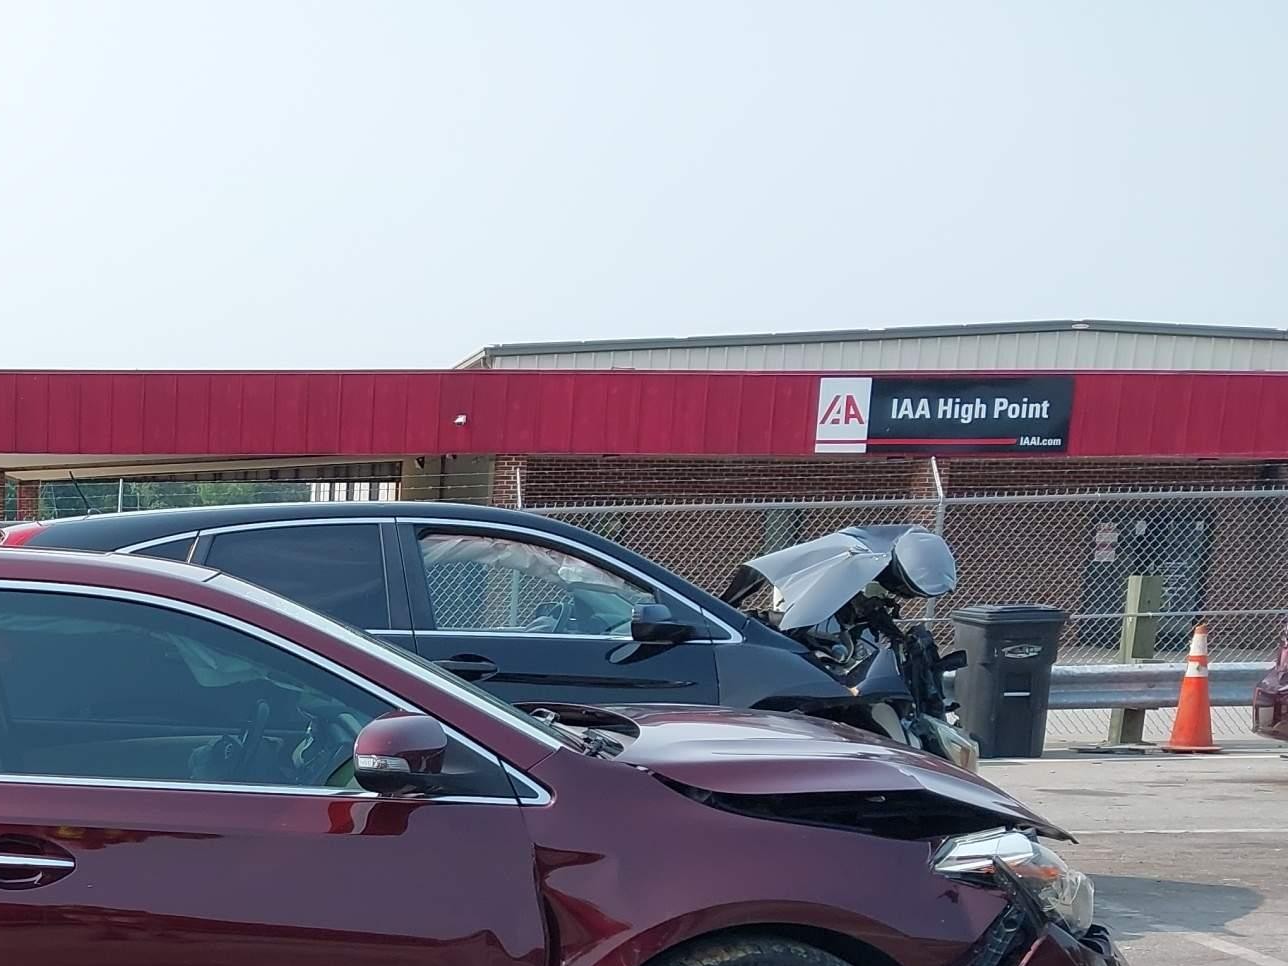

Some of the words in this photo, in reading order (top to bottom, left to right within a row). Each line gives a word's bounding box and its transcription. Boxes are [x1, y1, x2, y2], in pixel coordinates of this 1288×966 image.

[891, 398, 931, 419] IAA
[937, 398, 987, 424] High
[993, 398, 1050, 419] Point
[1020, 436, 1061, 446] IAAI.com
